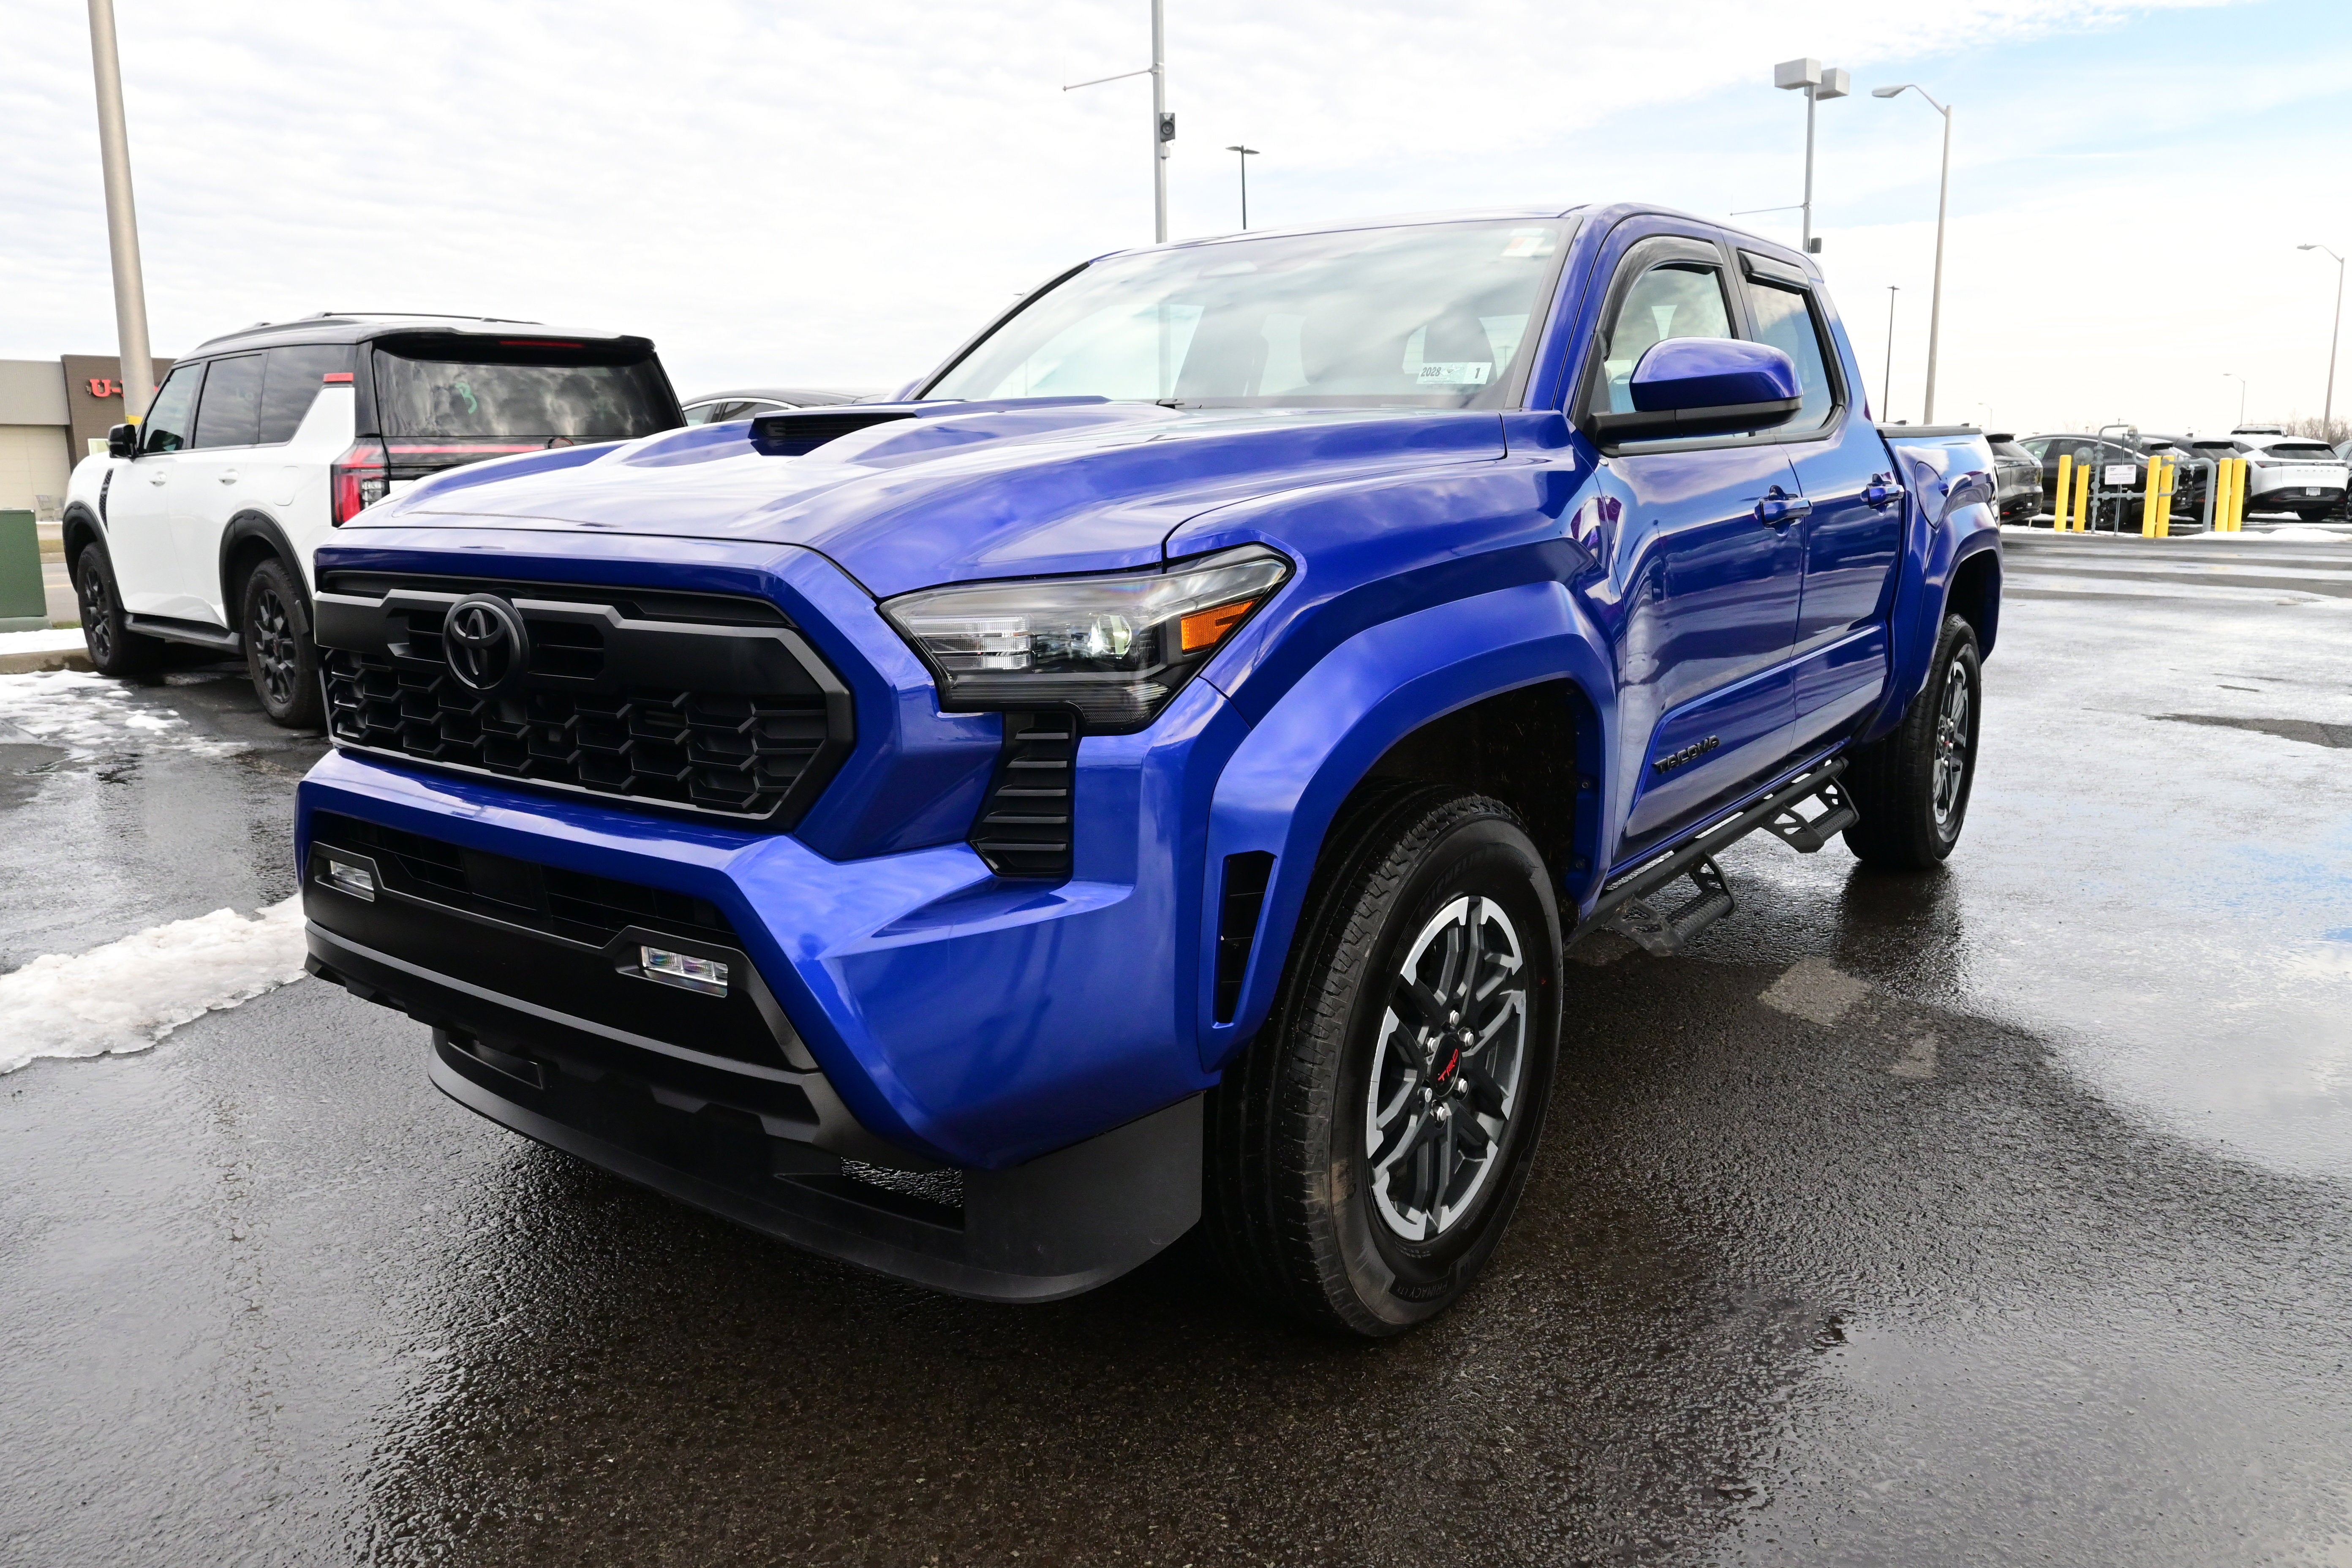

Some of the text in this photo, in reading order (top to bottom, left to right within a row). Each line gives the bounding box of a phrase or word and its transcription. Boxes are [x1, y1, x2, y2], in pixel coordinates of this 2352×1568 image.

[1421, 367, 1481, 379] 2028 1
[90, 378, 124, 397] U-
[1652, 735, 1720, 774] TACOMA
[1438, 1048, 1458, 1081] TRD
[1409, 1280, 1448, 1298] PRIMACY
